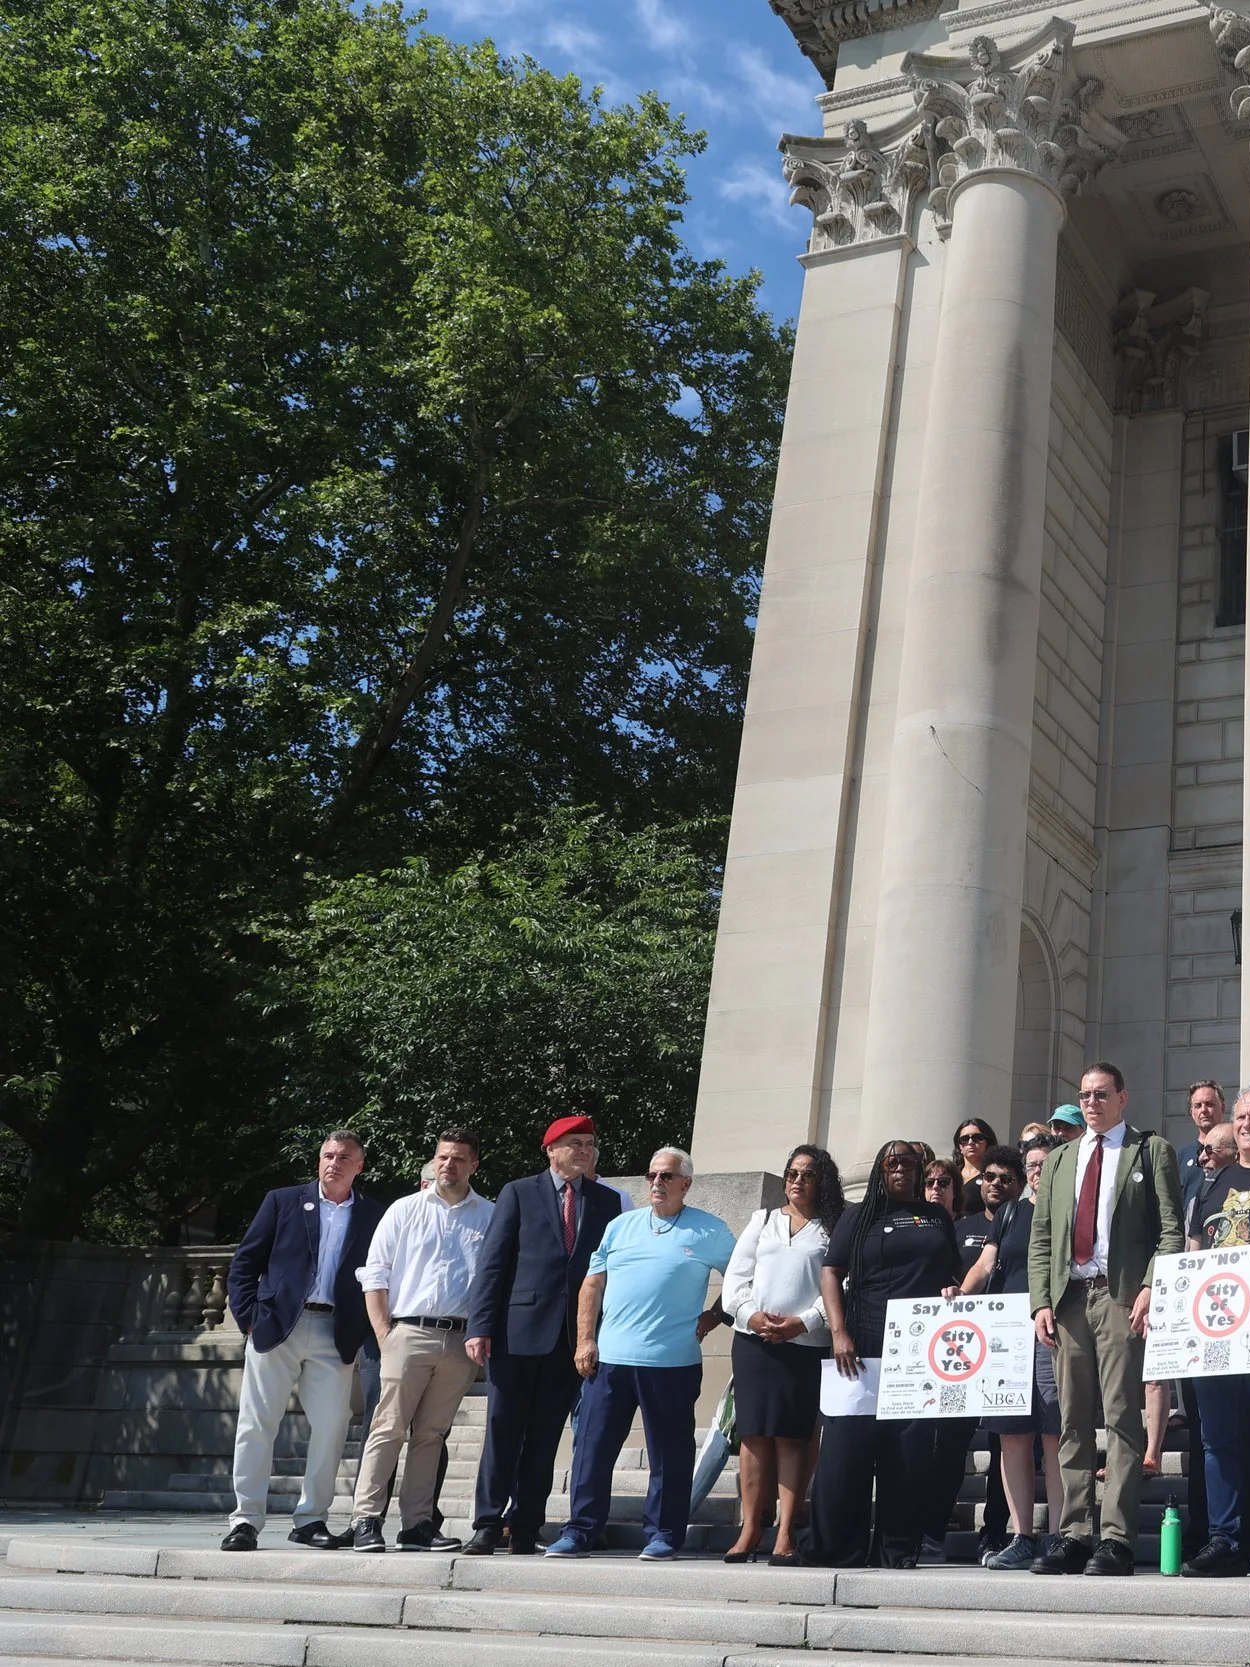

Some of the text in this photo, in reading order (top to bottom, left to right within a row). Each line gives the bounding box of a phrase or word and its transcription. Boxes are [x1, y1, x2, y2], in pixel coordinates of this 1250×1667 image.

[1178, 1258, 1206, 1270] Say
[1211, 1251, 1248, 1265] "NO"
[1206, 1284, 1239, 1297] City
[912, 1300, 1005, 1316] Say "NO" to
[1210, 1299, 1228, 1311] of
[1206, 1315, 1235, 1327] Yes
[941, 1331, 975, 1343] City
[946, 1345, 964, 1356] of
[942, 1360, 971, 1371] Yes
[984, 1392, 1026, 1405] NBCA
